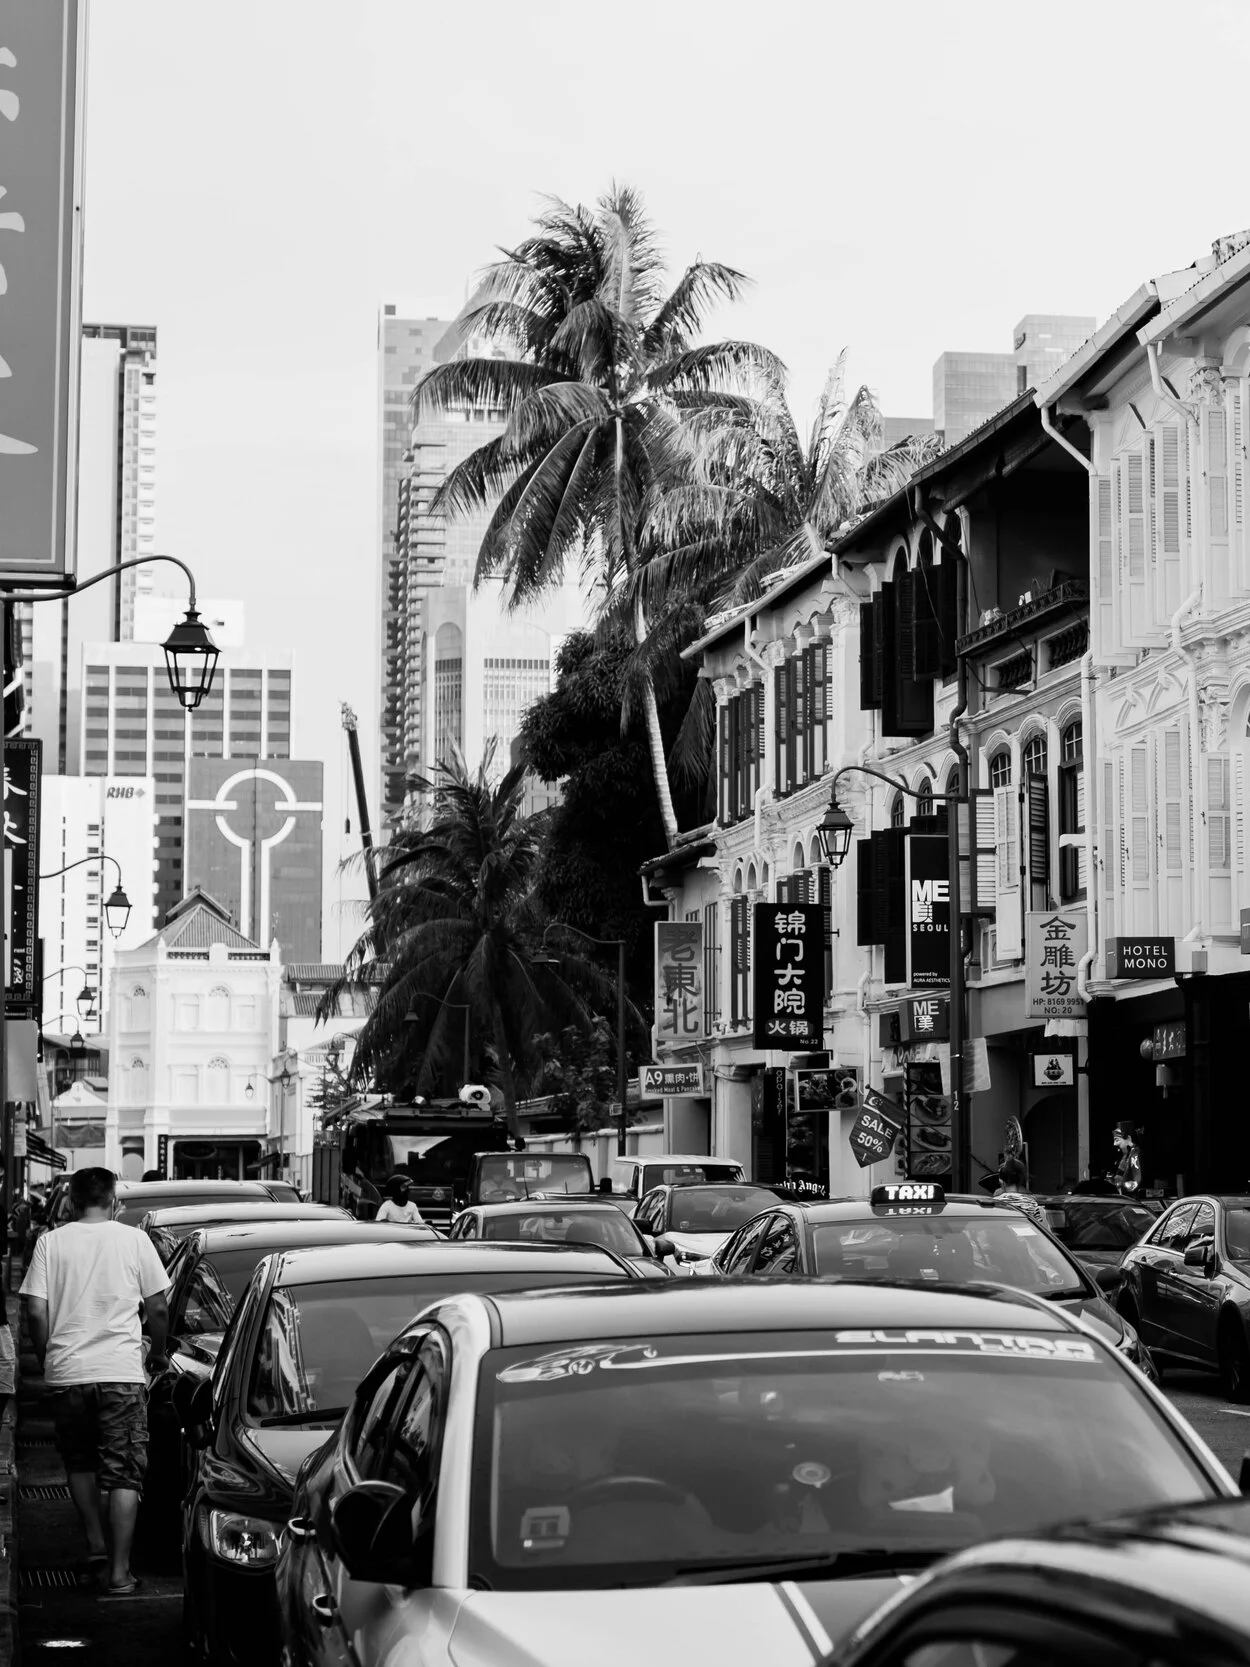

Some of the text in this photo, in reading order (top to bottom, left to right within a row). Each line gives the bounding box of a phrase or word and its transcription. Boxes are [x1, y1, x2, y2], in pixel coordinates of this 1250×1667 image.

[107, 787, 134, 798] RHB
[912, 880, 950, 902] ME
[912, 924, 949, 932] SEOUL
[1040, 916, 1077, 996] 金雕坊
[1123, 946, 1168, 956] HOTEL
[774, 910, 806, 1015] 锦门大院
[1124, 959, 1168, 968] MONO
[662, 926, 700, 1035] 老東北
[913, 1000, 939, 1015] ME
[1044, 1006, 1072, 1014] NO: 20
[768, 1020, 809, 1035] 火锅
[645, 1071, 663, 1085] A9
[861, 1114, 893, 1140] SALE
[857, 1131, 883, 1153] 50%
[885, 1185, 935, 1200] TAXI
